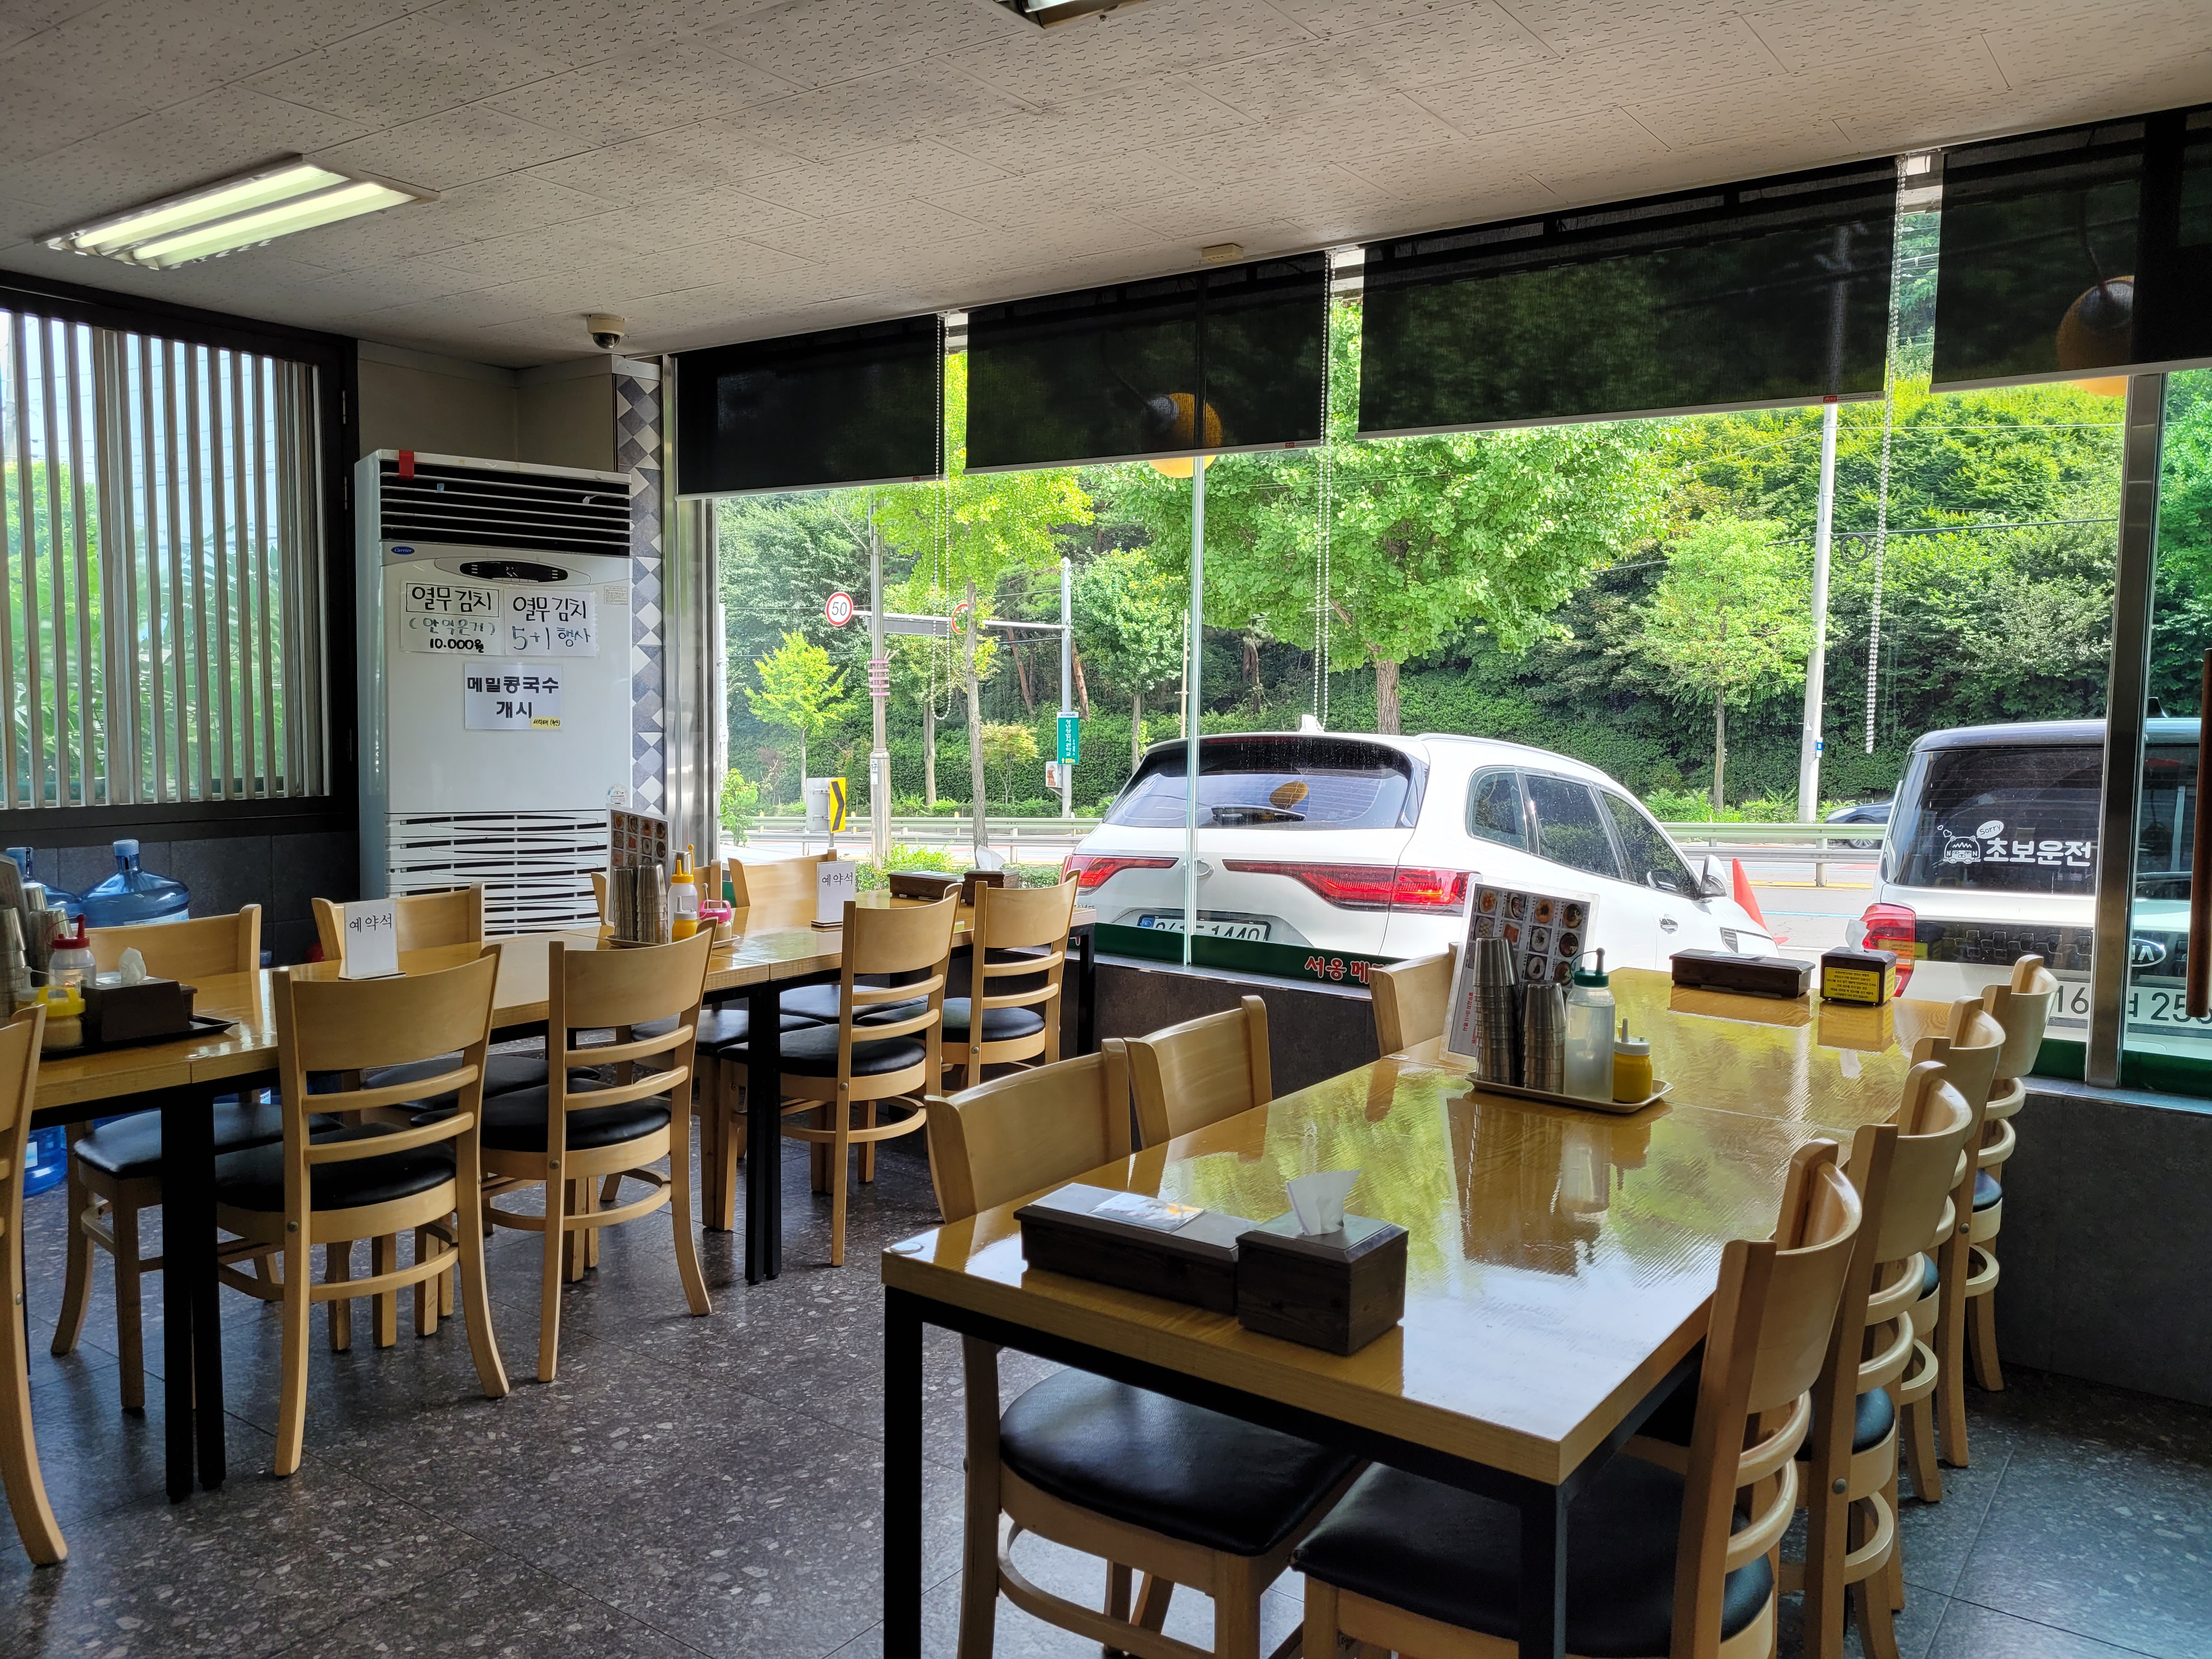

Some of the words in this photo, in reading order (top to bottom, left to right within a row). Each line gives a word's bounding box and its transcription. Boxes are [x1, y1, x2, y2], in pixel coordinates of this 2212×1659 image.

[832, 602, 847, 616] 50
[512, 625, 550, 650] 5+1
[556, 627, 591, 647] 행사
[467, 676, 559, 694] 메밀콩국수
[496, 701, 532, 719] 개시
[1979, 824, 2001, 835] Sorry
[1983, 837, 2091, 867] 초보운전
[822, 872, 853, 887] 예약석
[349, 913, 392, 933] 예약석
[1305, 956, 1347, 981] 서옹
